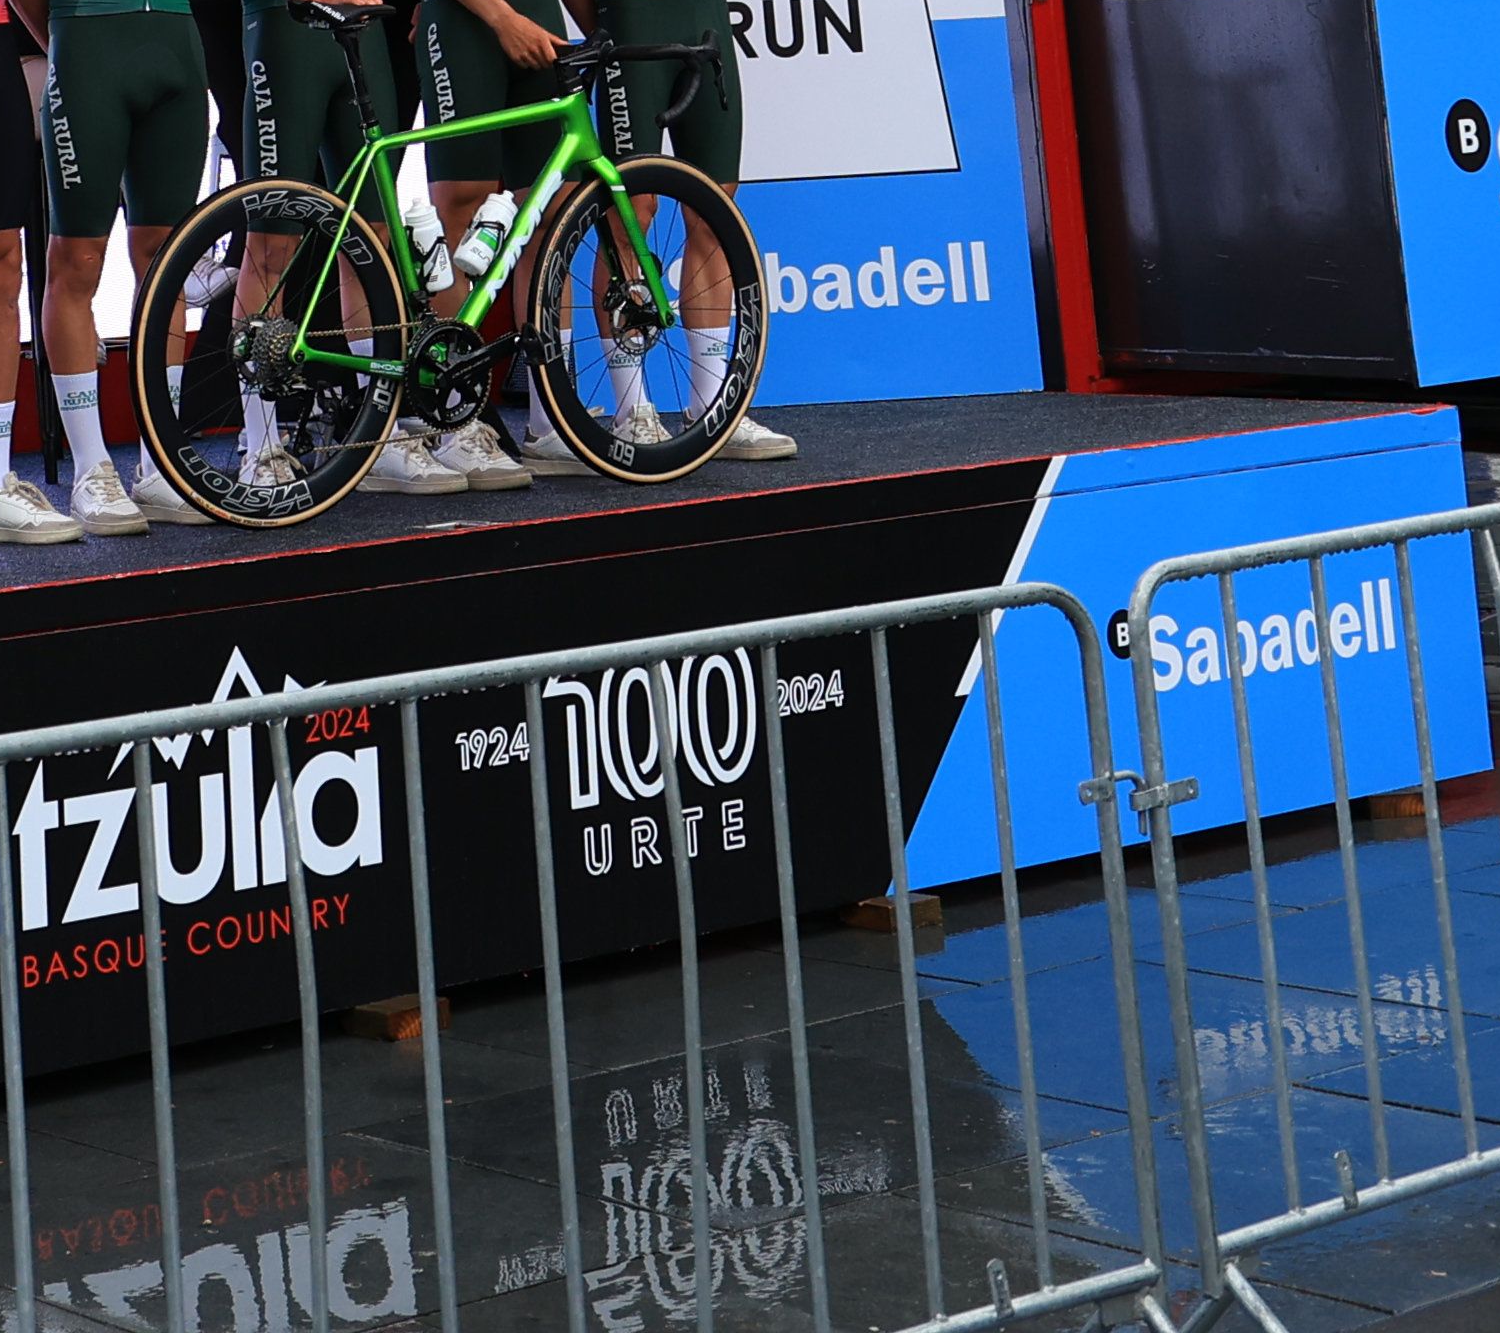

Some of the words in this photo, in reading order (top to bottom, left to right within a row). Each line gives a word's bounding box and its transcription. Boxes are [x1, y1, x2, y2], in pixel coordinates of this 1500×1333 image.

[764, 240, 991, 314] badell
[305, 704, 371, 743] 2024
[455, 722, 529, 772] 1924
[543, 646, 757, 810] 100
[776, 669, 844, 717] 2024
[583, 799, 746, 876] URTE
[186, 893, 351, 955] COUNRY
